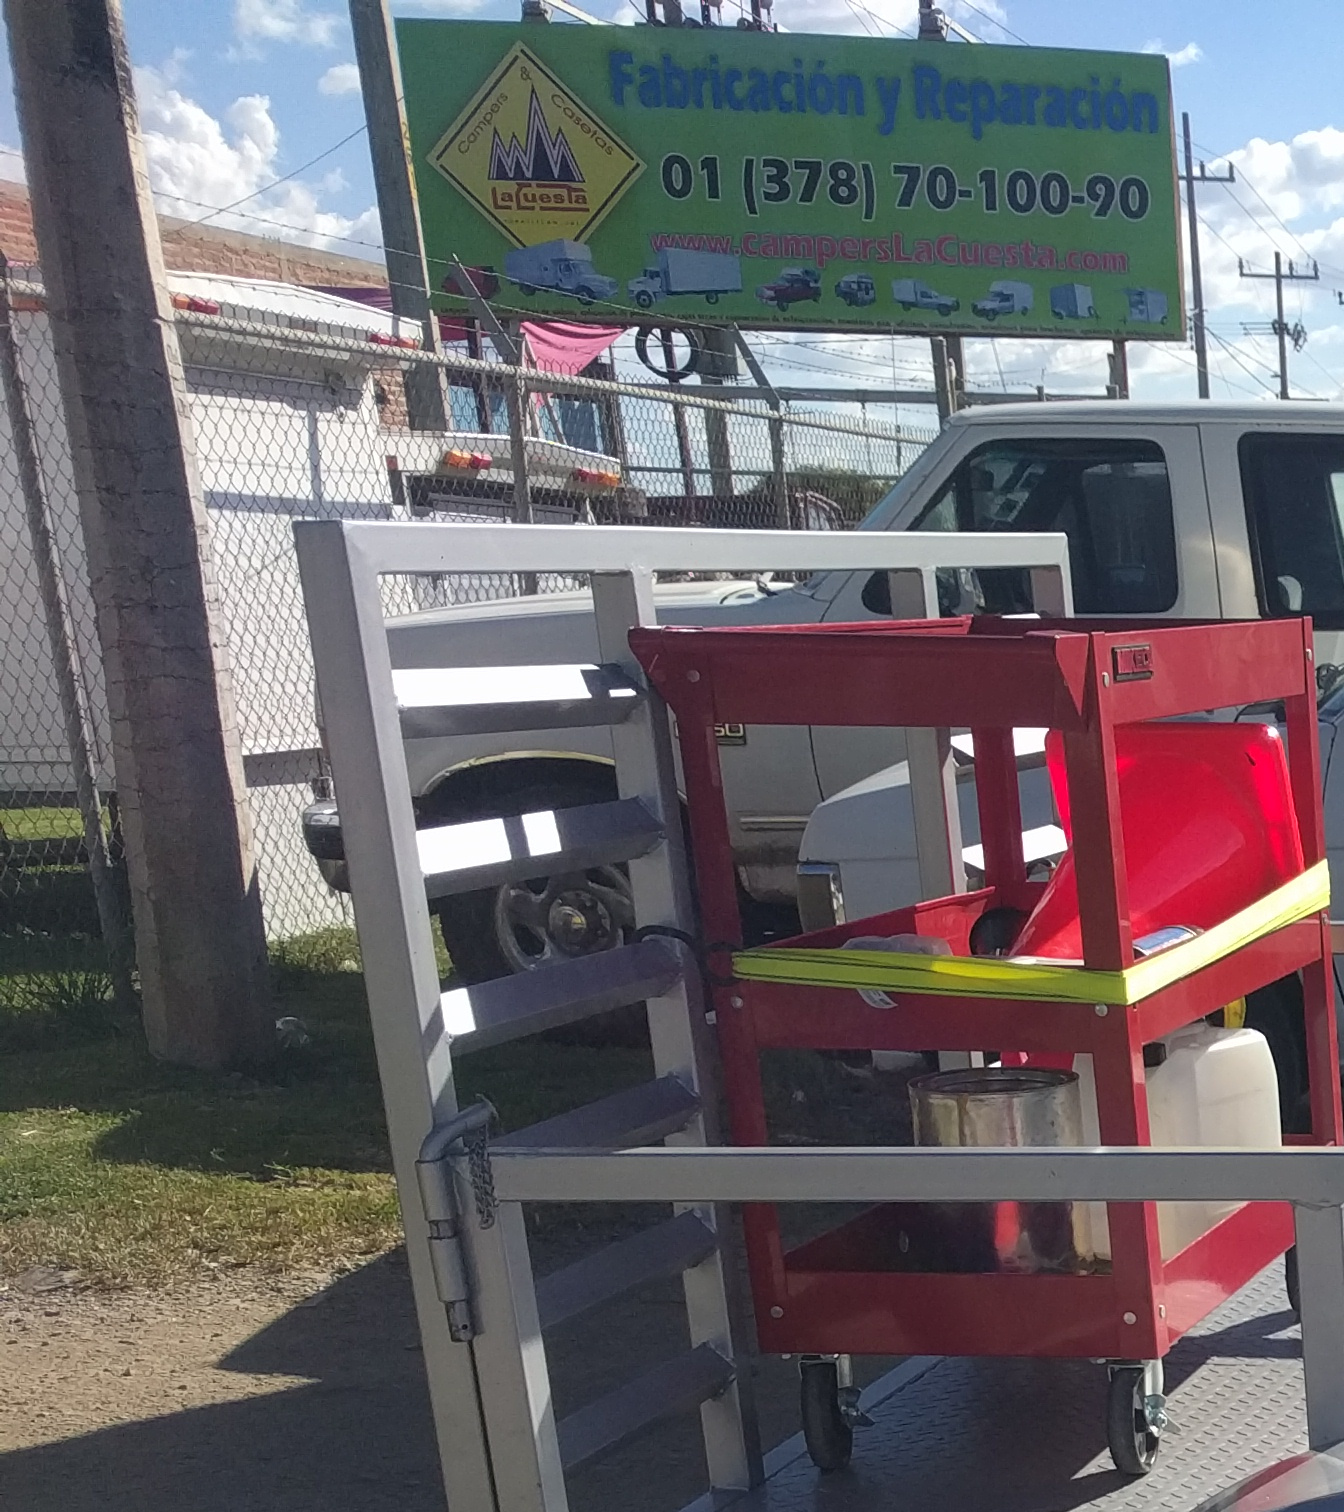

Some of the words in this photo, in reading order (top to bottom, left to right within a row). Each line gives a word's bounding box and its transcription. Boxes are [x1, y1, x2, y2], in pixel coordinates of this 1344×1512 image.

[520, 66, 532, 82] &
[608, 50, 864, 116] Fabricación
[876, 76, 901, 136] y
[912, 64, 1160, 141] Reparación
[457, 92, 509, 155] Campers
[550, 93, 614, 156] Casetas
[660, 152, 722, 200] 01
[743, 156, 877, 222] (378)
[891, 162, 1151, 221] 70-100-90
